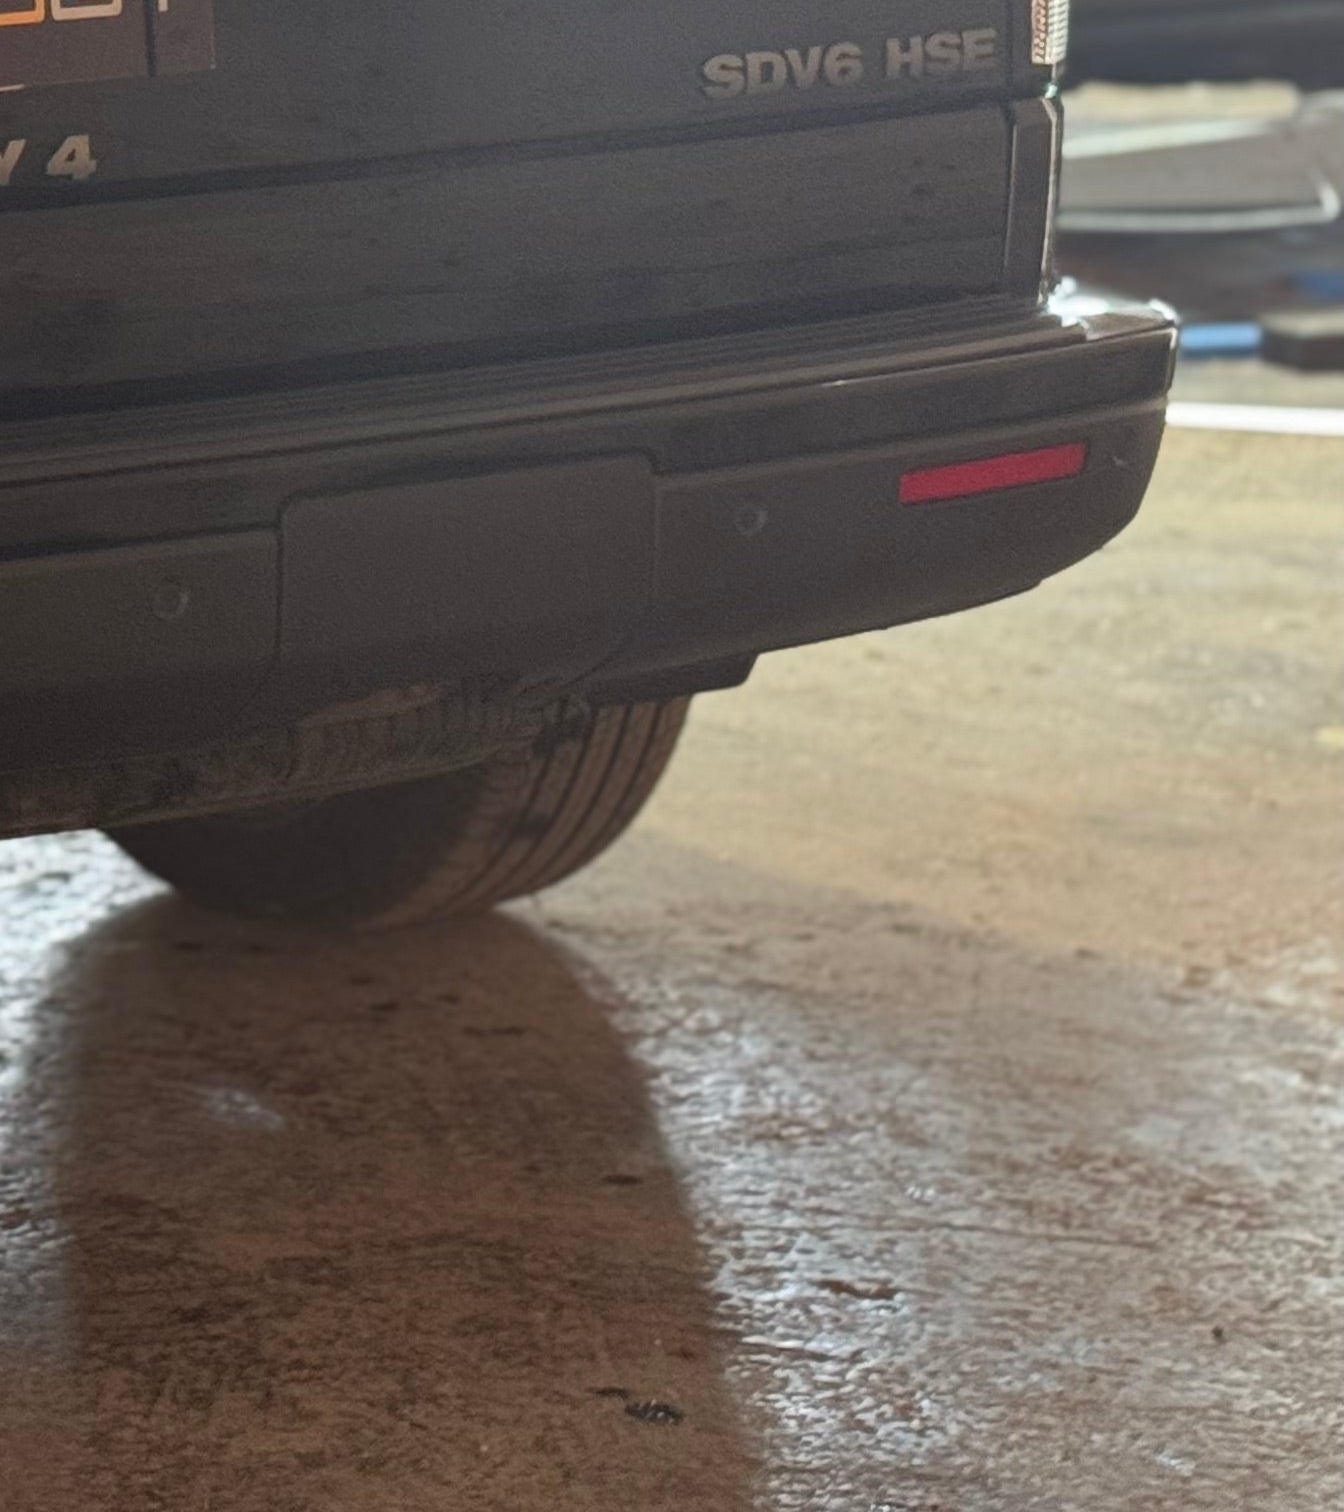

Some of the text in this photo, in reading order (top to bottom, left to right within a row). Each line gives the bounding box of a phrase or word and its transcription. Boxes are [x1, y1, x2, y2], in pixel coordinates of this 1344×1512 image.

[702, 26, 999, 98] SDV6 HSE
[45, 134, 98, 183] 4
